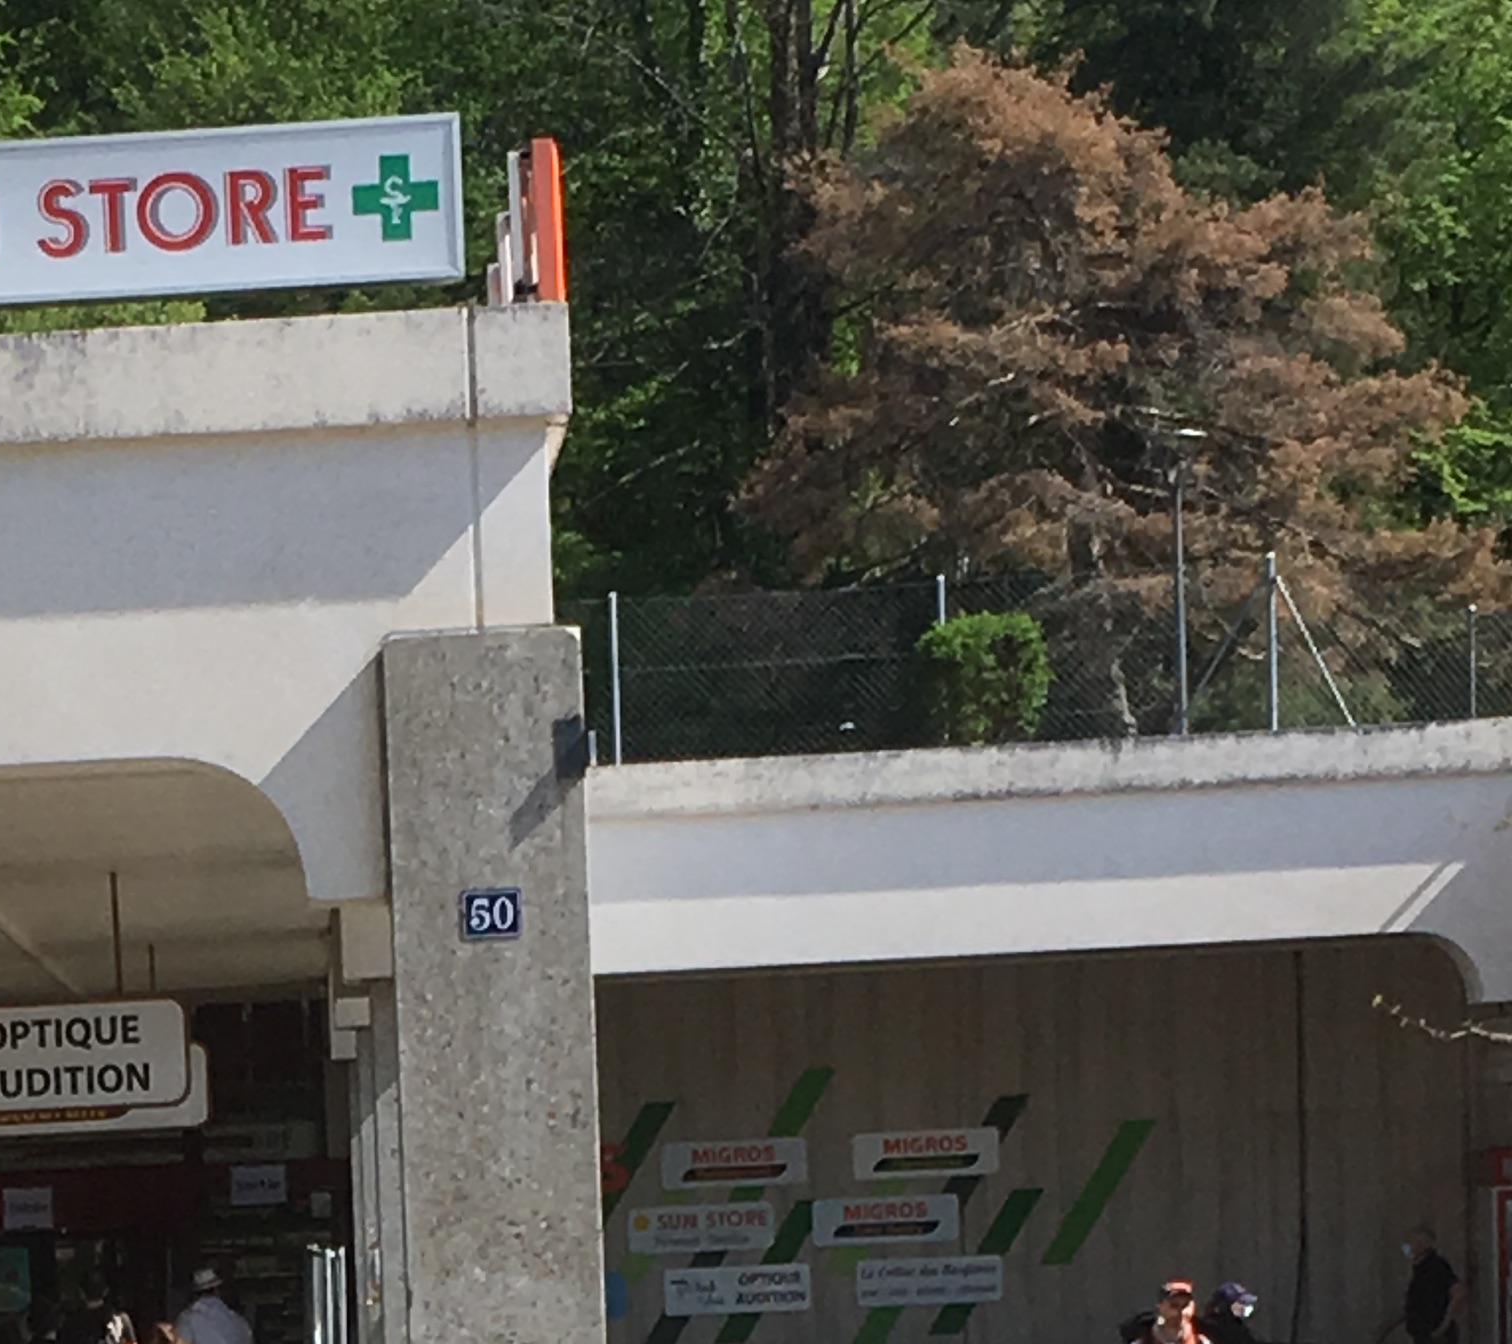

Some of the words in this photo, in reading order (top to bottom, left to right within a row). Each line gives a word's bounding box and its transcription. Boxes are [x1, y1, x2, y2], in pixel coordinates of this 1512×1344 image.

[37, 163, 333, 259] STORE
[470, 896, 514, 931] 50
[691, 1144, 776, 1164] MIGROS
[882, 1134, 968, 1154] MIGROS
[657, 1213, 699, 1230] SUN
[706, 1209, 768, 1229] STORE
[843, 1200, 928, 1221] MIGROS
